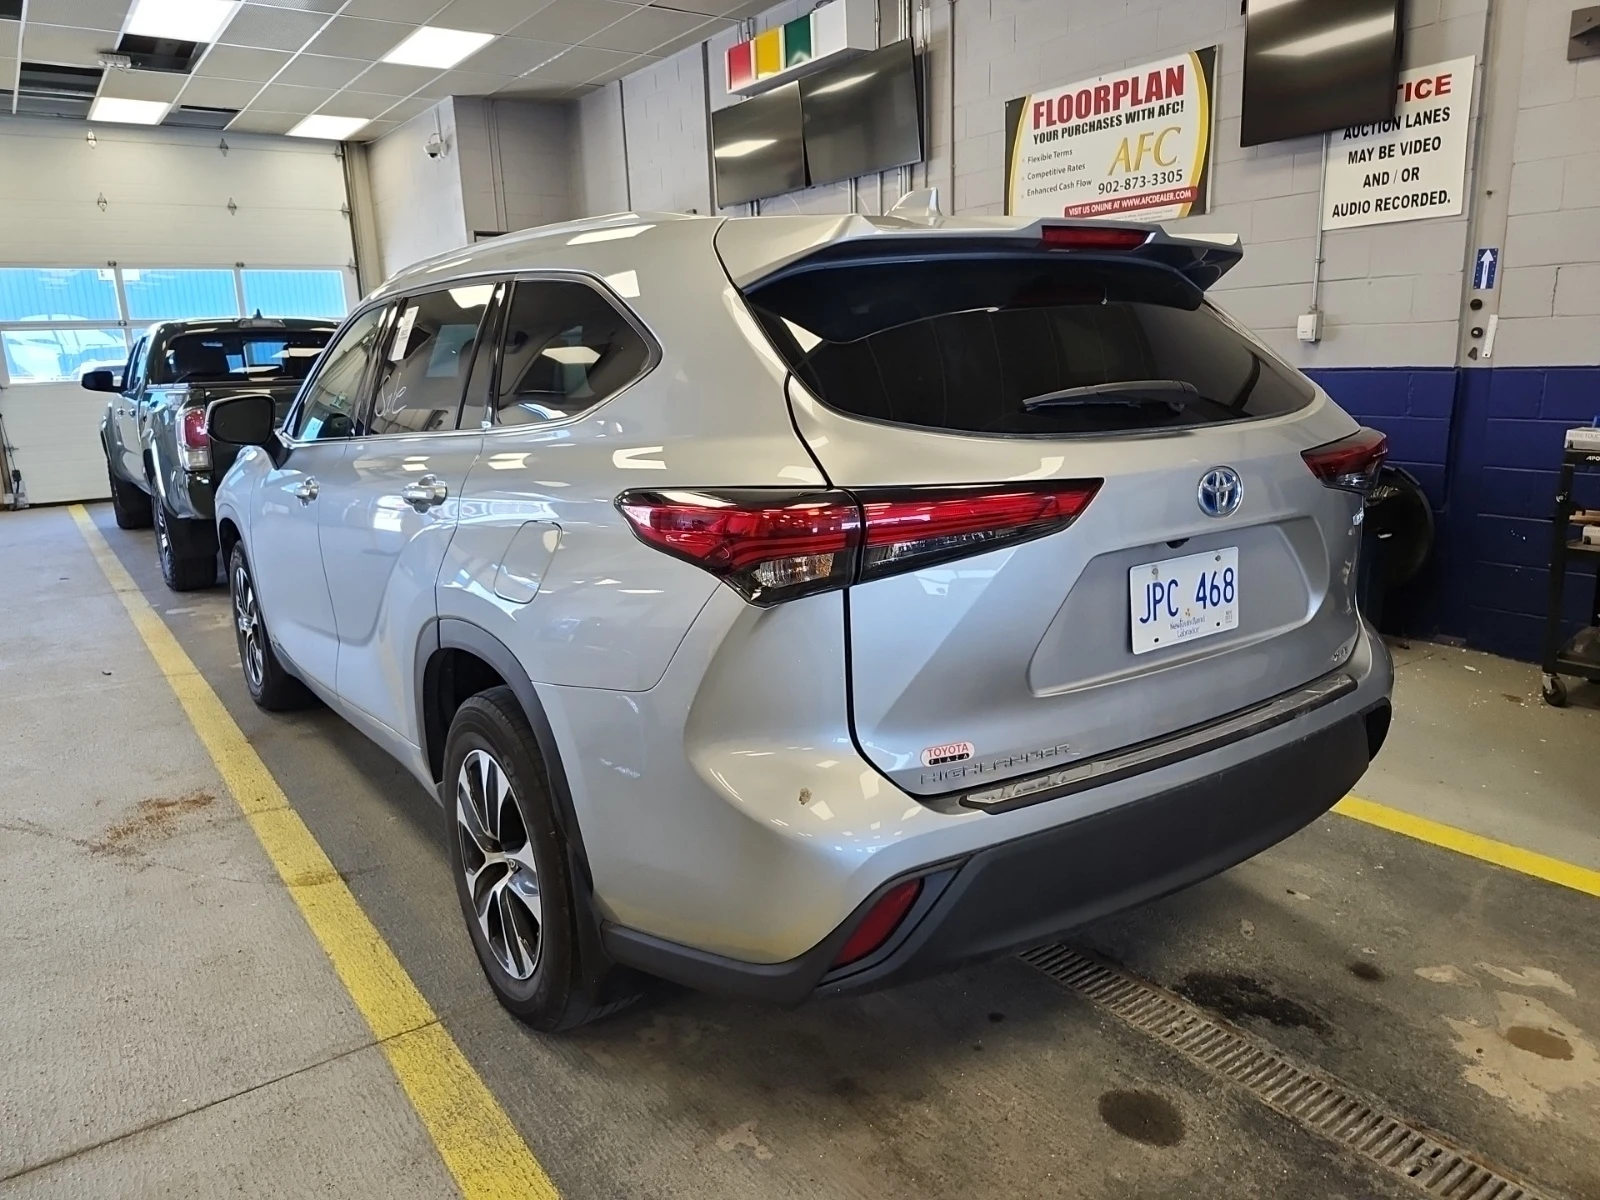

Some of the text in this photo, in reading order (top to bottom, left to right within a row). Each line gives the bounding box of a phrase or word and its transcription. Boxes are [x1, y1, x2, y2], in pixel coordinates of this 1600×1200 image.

[1033, 64, 1185, 130] FLOORPLAN
[1033, 100, 1184, 145] YOUR PURCHASES WITH AFC!
[1343, 106, 1451, 140] AUCTION LANES
[1027, 148, 1073, 164] Flexible Terms
[1107, 126, 1182, 176] AFC
[1348, 136, 1442, 165] MAY BE VIDEO
[1027, 162, 1086, 181] Competitive Rates
[1098, 169, 1183, 195] 902-873-3305
[1362, 171, 1390, 188] AND
[1401, 166, 1420, 183] OR
[1027, 178, 1093, 197] Enhanced Cash Flow
[1068, 188, 1192, 216] VISIT US ONLINE AT WWW.AFCDEALER.COM
[1332, 189, 1451, 218] AUDIO RECORDED.
[1139, 567, 1235, 624] JPC 468
[920, 743, 1070, 785] HIGHLANDER
[927, 743, 969, 758] TOYOTA
